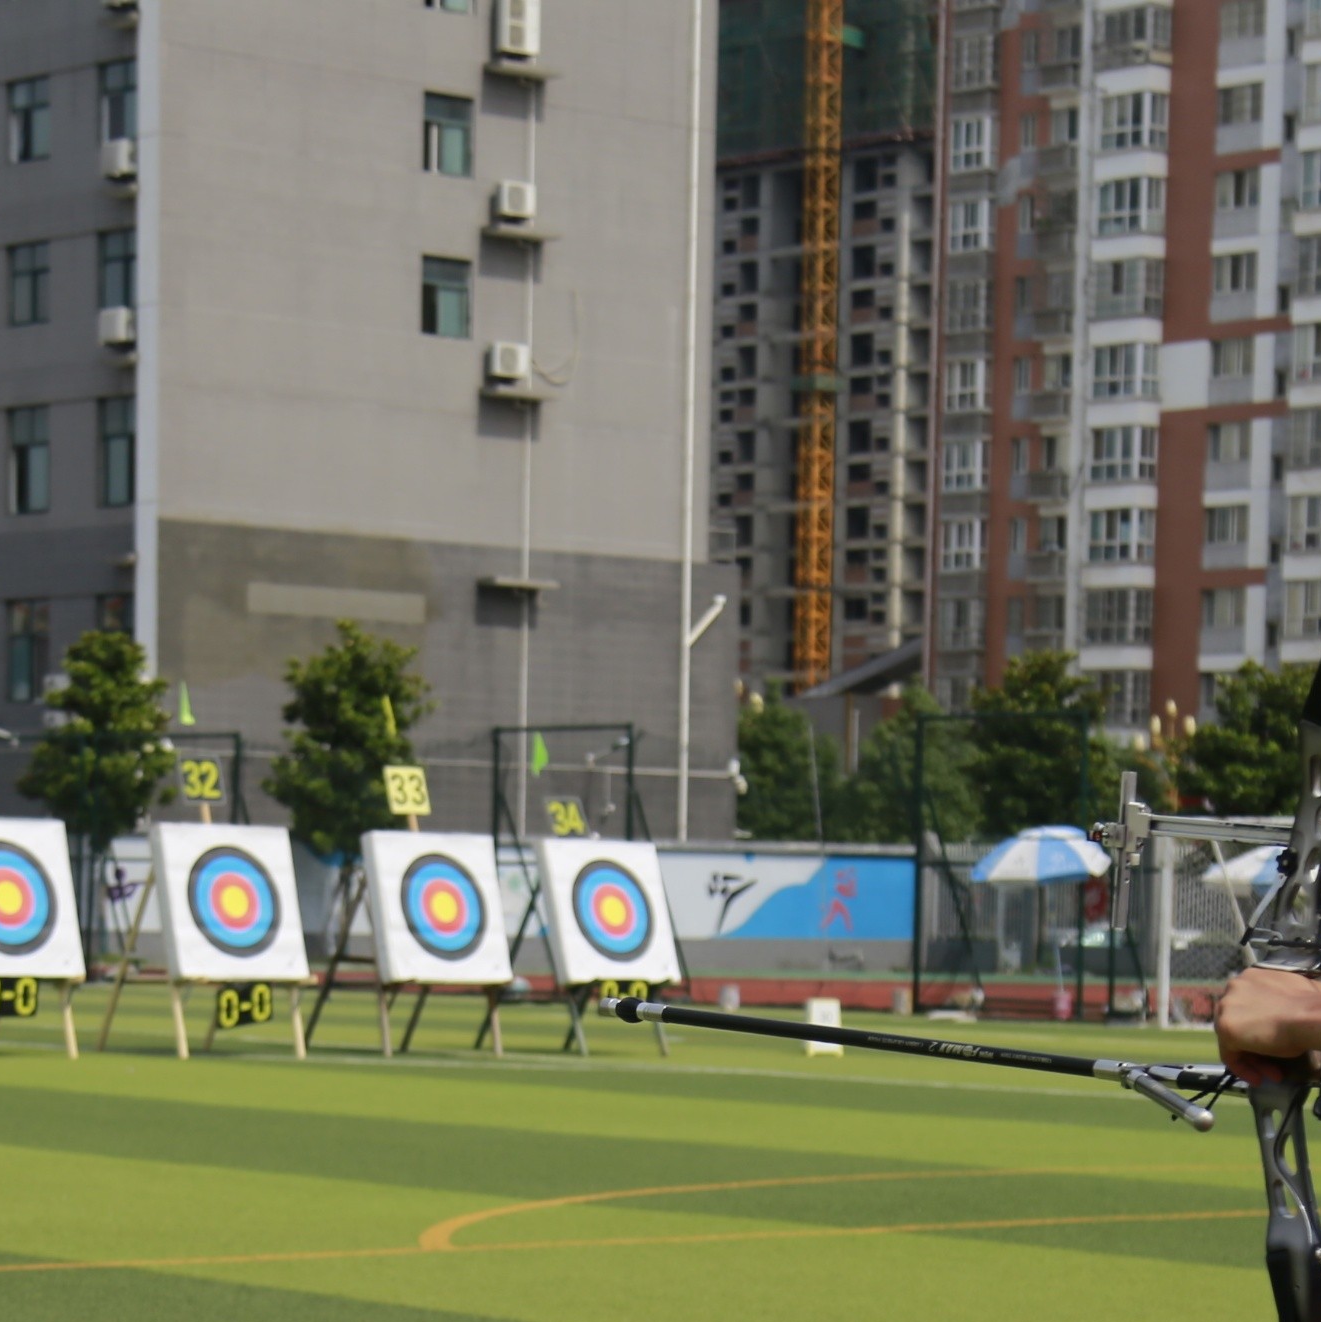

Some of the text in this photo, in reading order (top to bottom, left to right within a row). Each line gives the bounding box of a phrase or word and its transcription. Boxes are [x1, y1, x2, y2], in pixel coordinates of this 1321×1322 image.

[181, 759, 221, 800] 32
[388, 772, 429, 809] 33
[547, 801, 586, 836] 34
[218, 982, 272, 1029] 0-0
